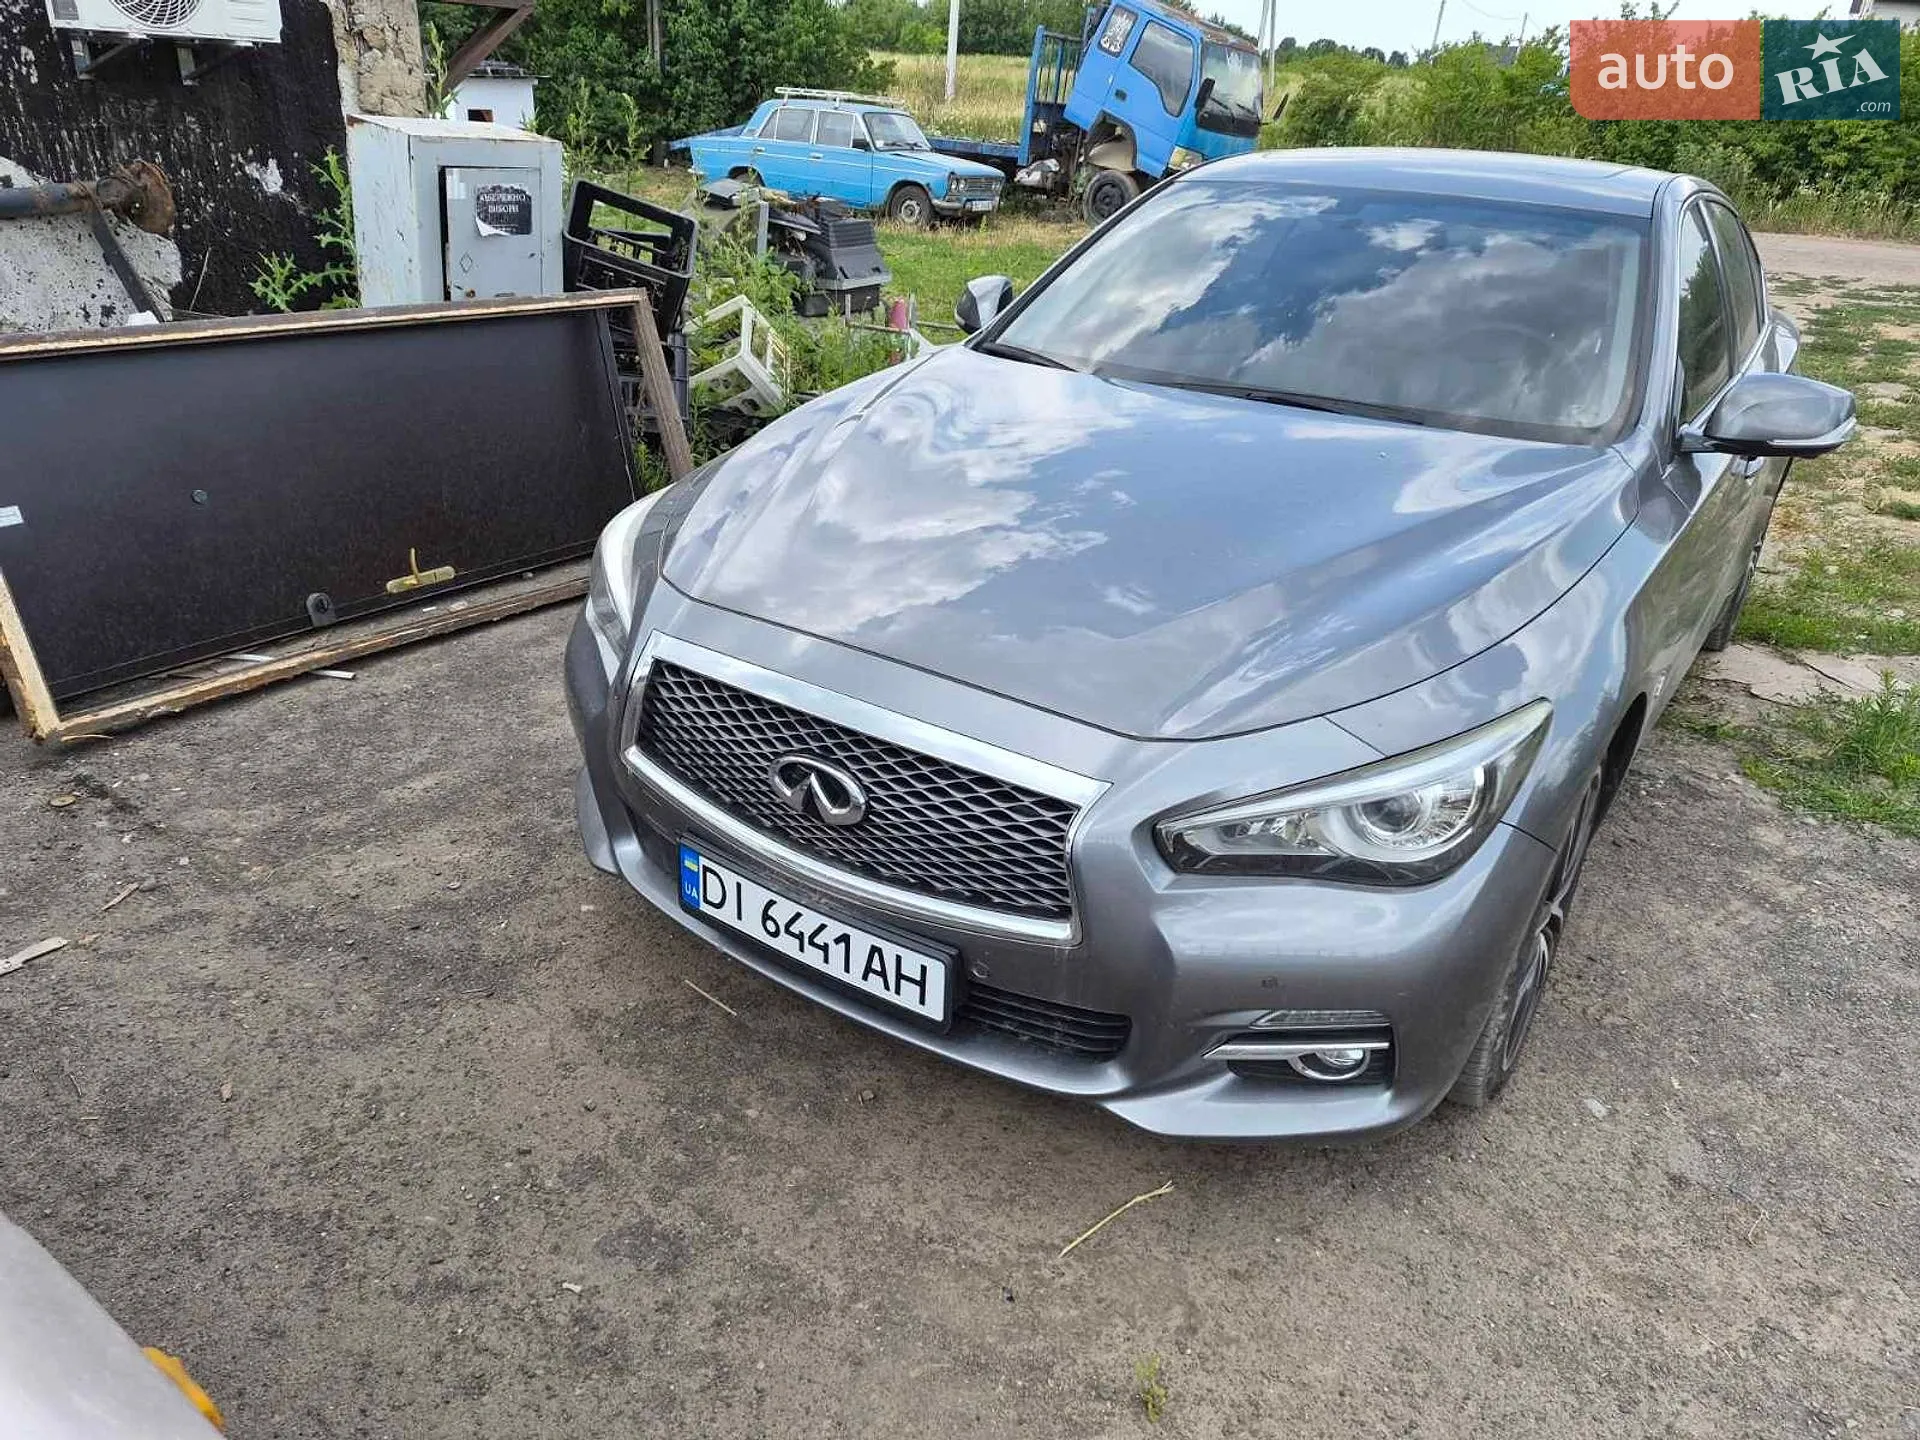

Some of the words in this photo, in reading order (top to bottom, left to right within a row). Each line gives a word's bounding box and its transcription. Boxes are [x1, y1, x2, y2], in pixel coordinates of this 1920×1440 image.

[684, 881, 698, 900] UA
[702, 865, 743, 921] DI
[761, 899, 852, 974] 6441
[861, 945, 928, 1006] AH
